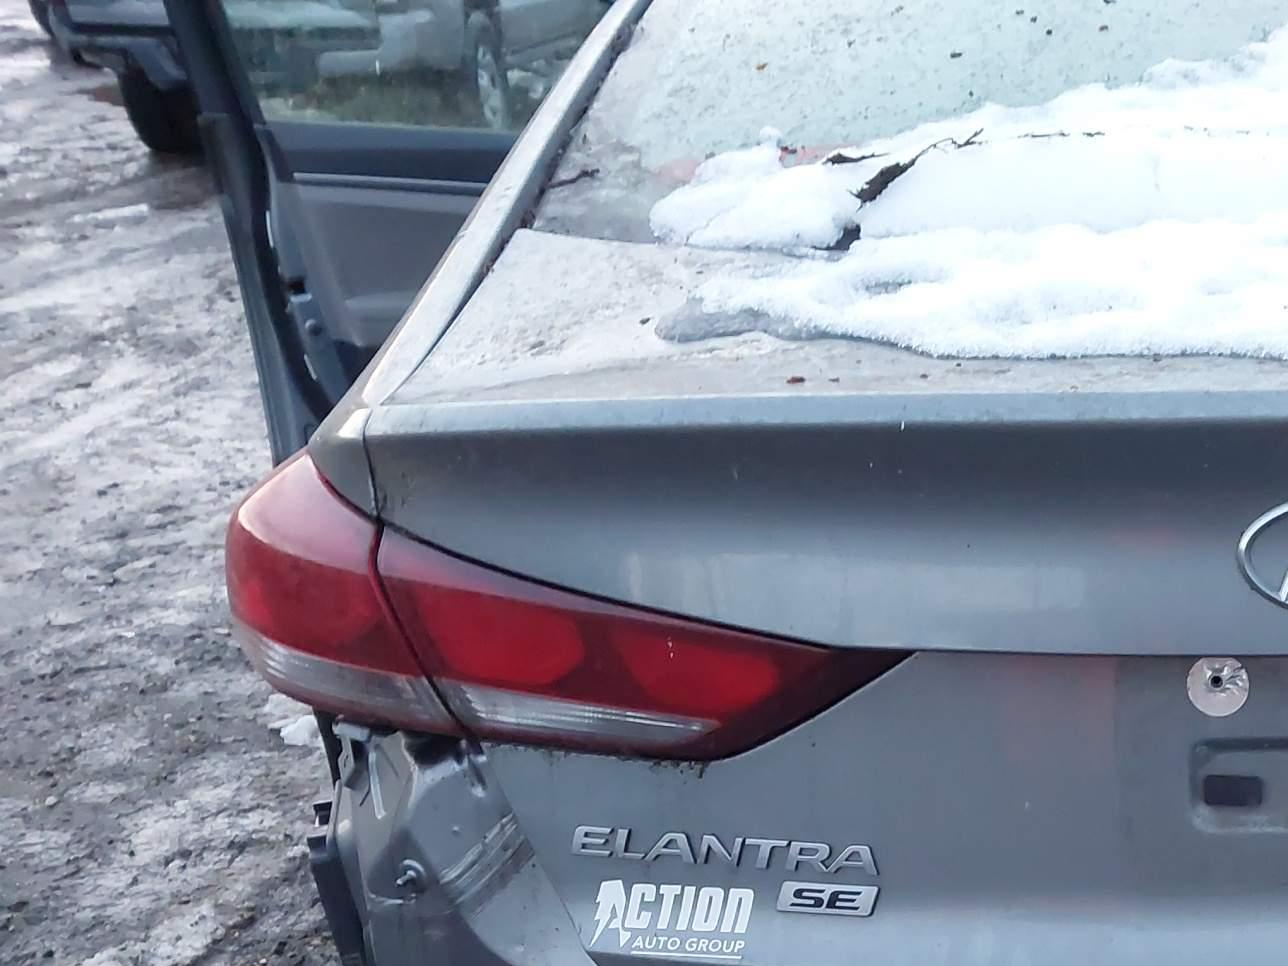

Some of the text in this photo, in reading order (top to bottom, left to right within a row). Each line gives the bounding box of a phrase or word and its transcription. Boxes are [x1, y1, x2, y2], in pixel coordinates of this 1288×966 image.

[570, 825, 879, 875] ELANTRA
[590, 879, 755, 948] ACTION
[788, 888, 863, 912] SE
[631, 935, 745, 953] AUTO GROUP
